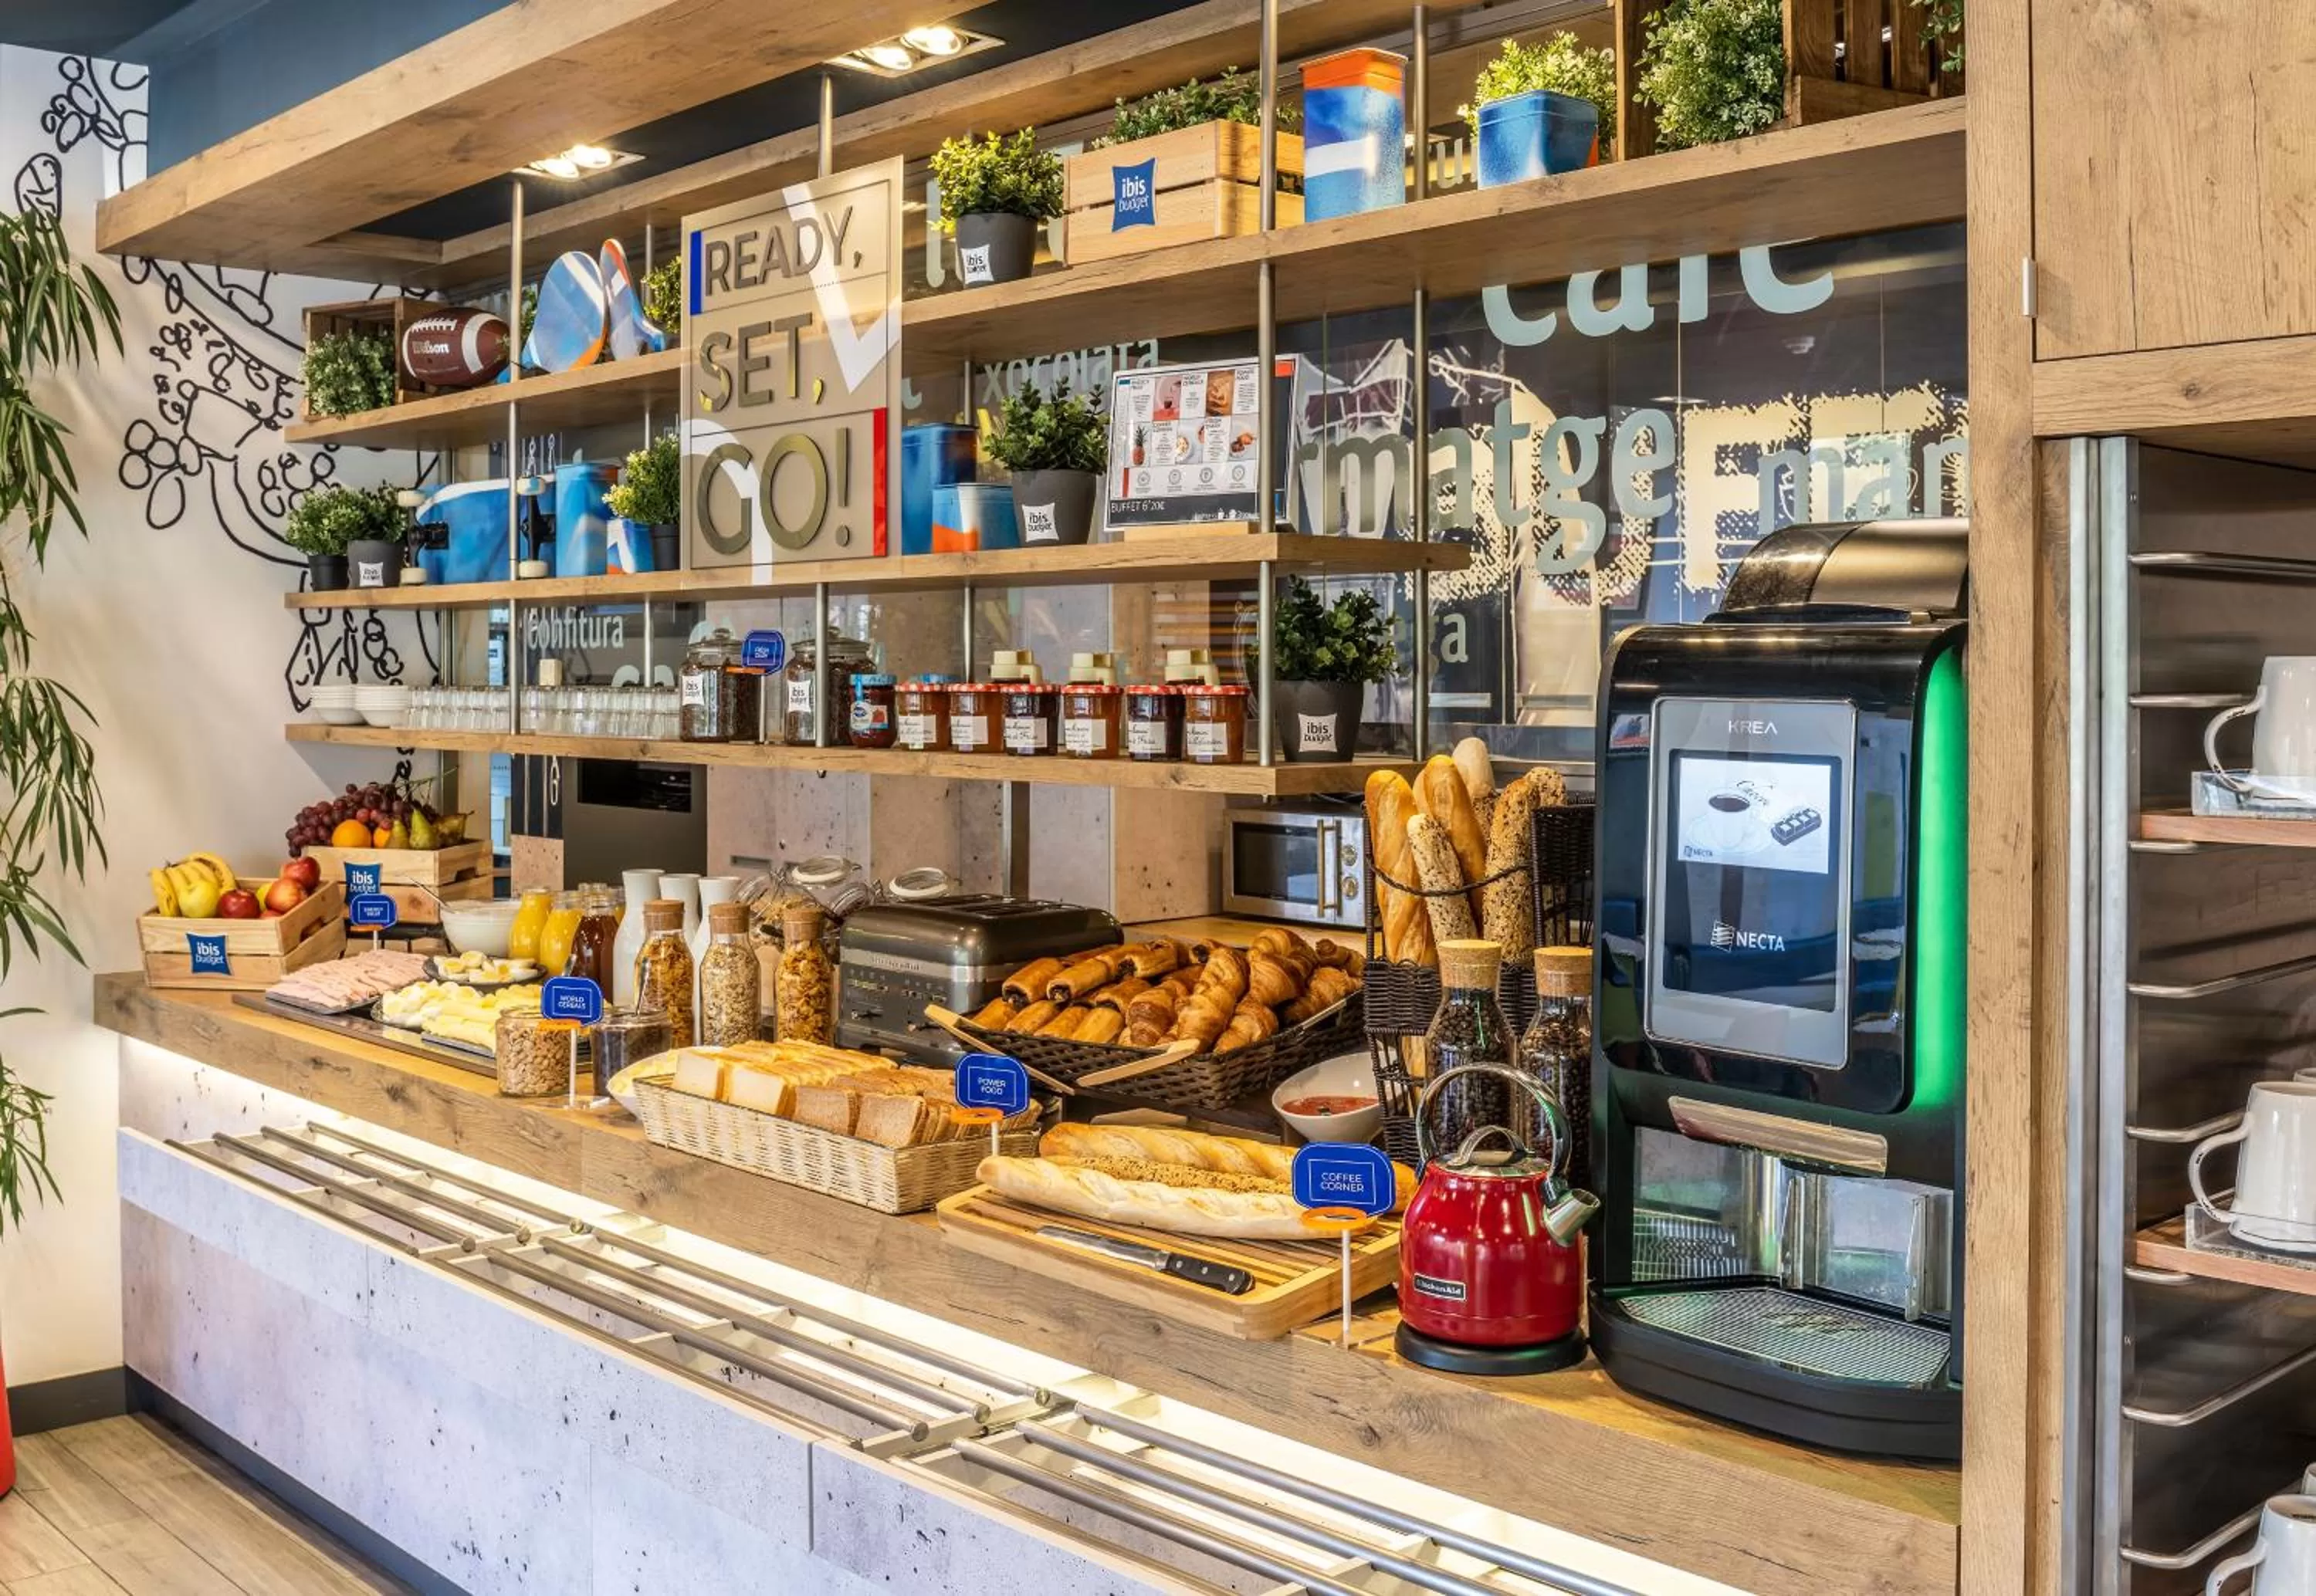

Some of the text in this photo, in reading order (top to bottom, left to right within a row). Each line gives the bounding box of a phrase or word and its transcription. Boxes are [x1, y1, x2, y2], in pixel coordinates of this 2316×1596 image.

[1122, 176, 1146, 198] ibis
[1119, 194, 1149, 212] budget
[706, 205, 862, 296] READY,
[412, 340, 449, 354] Wilson
[699, 312, 823, 412] SET,
[697, 428, 850, 555] GO!
[1112, 501, 1140, 513] BUFFET
[1029, 512, 1048, 523] ibis
[1307, 722, 1328, 733] ibis
[1729, 720, 1778, 735] KREA
[352, 870, 373, 884] ibis
[1736, 931, 1785, 952] NECTA
[197, 942, 220, 955] ibis
[558, 1001, 586, 1009] CEREALS
[978, 1077, 1006, 1087] POWER
[981, 1087, 1003, 1095] FOOD
[1321, 1172, 1362, 1182] COFFEE
[1320, 1182, 1364, 1192] CORNER
